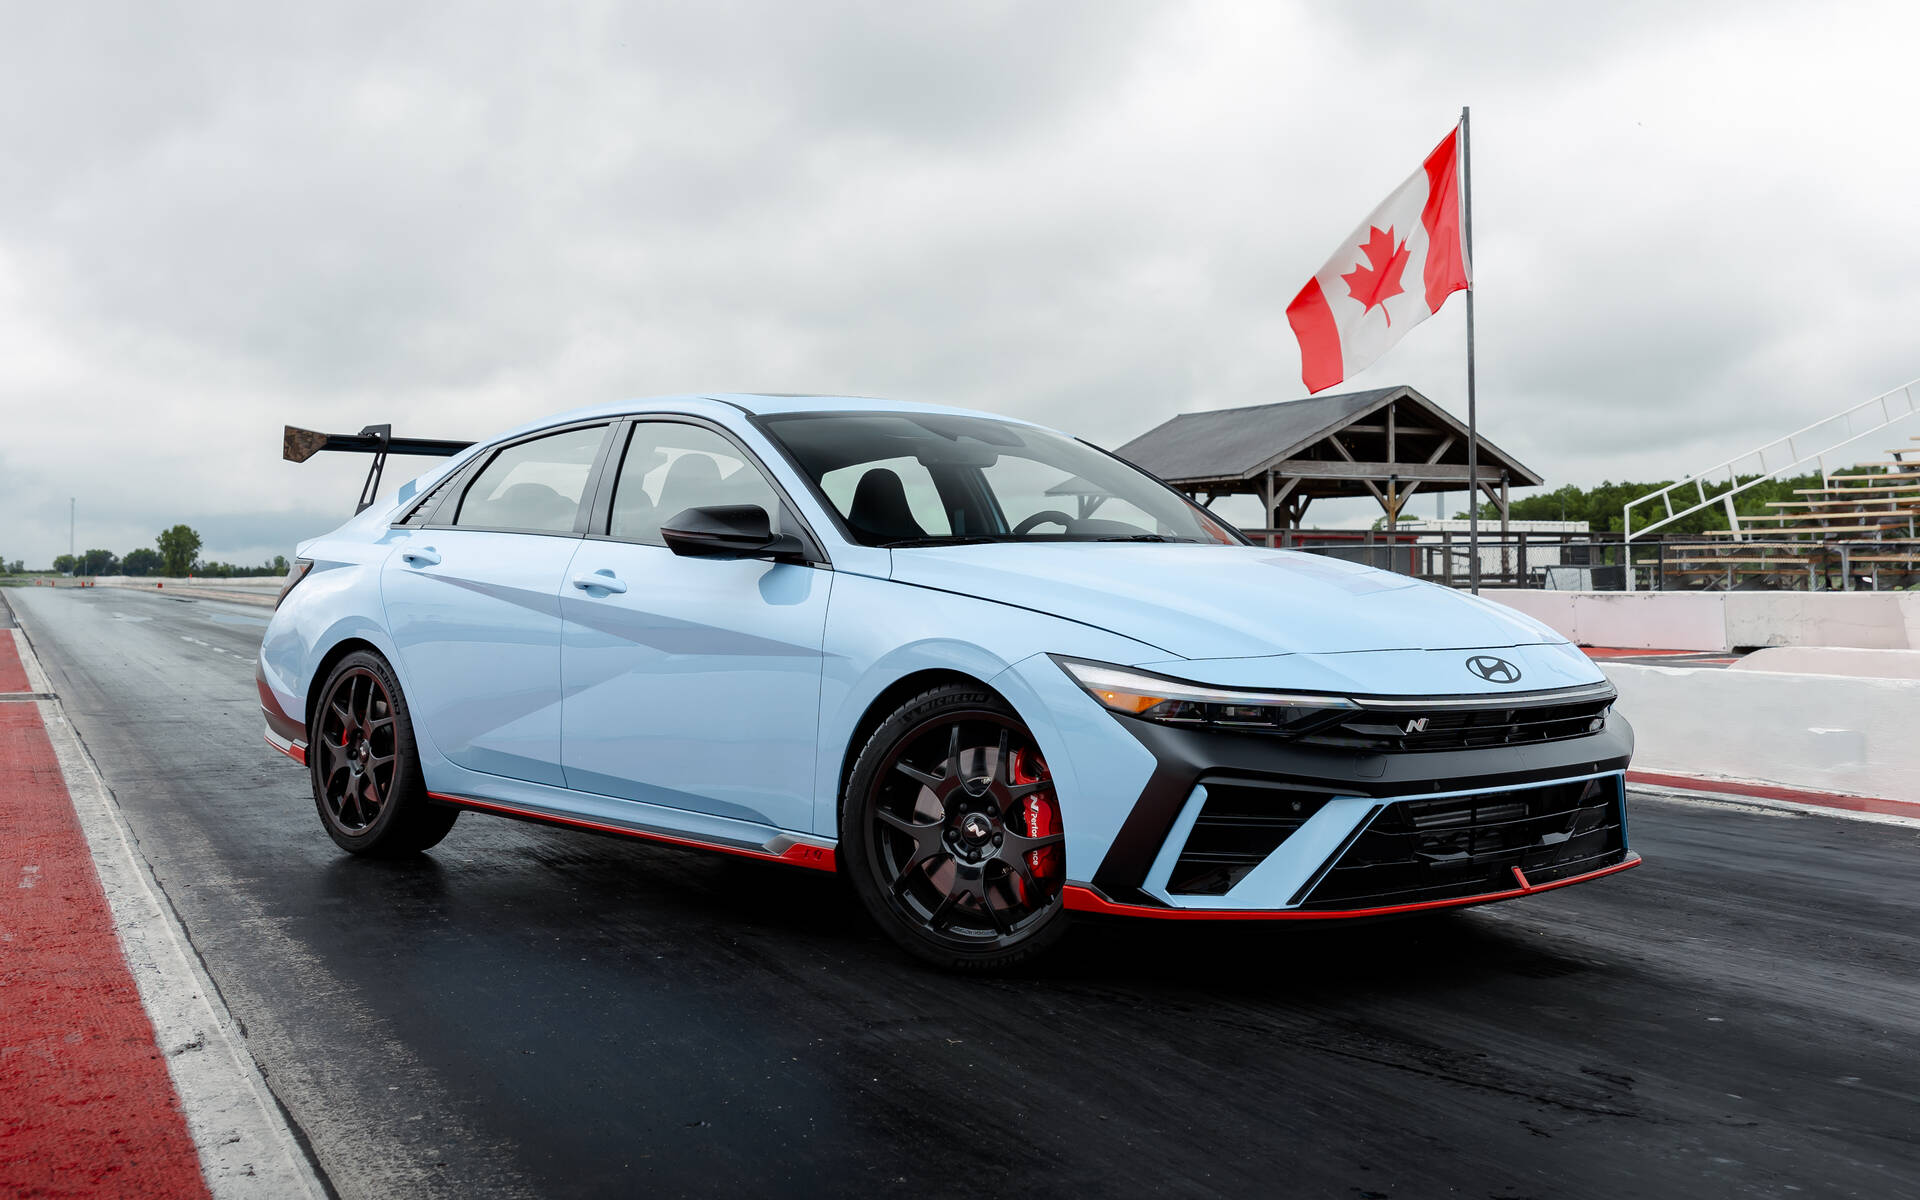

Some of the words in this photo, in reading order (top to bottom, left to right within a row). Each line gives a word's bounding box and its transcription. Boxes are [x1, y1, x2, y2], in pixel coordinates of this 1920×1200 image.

[920, 693, 985, 713] MICHELIN
[1406, 718, 1429, 732] N
[1031, 813, 1039, 866] Perfornce
